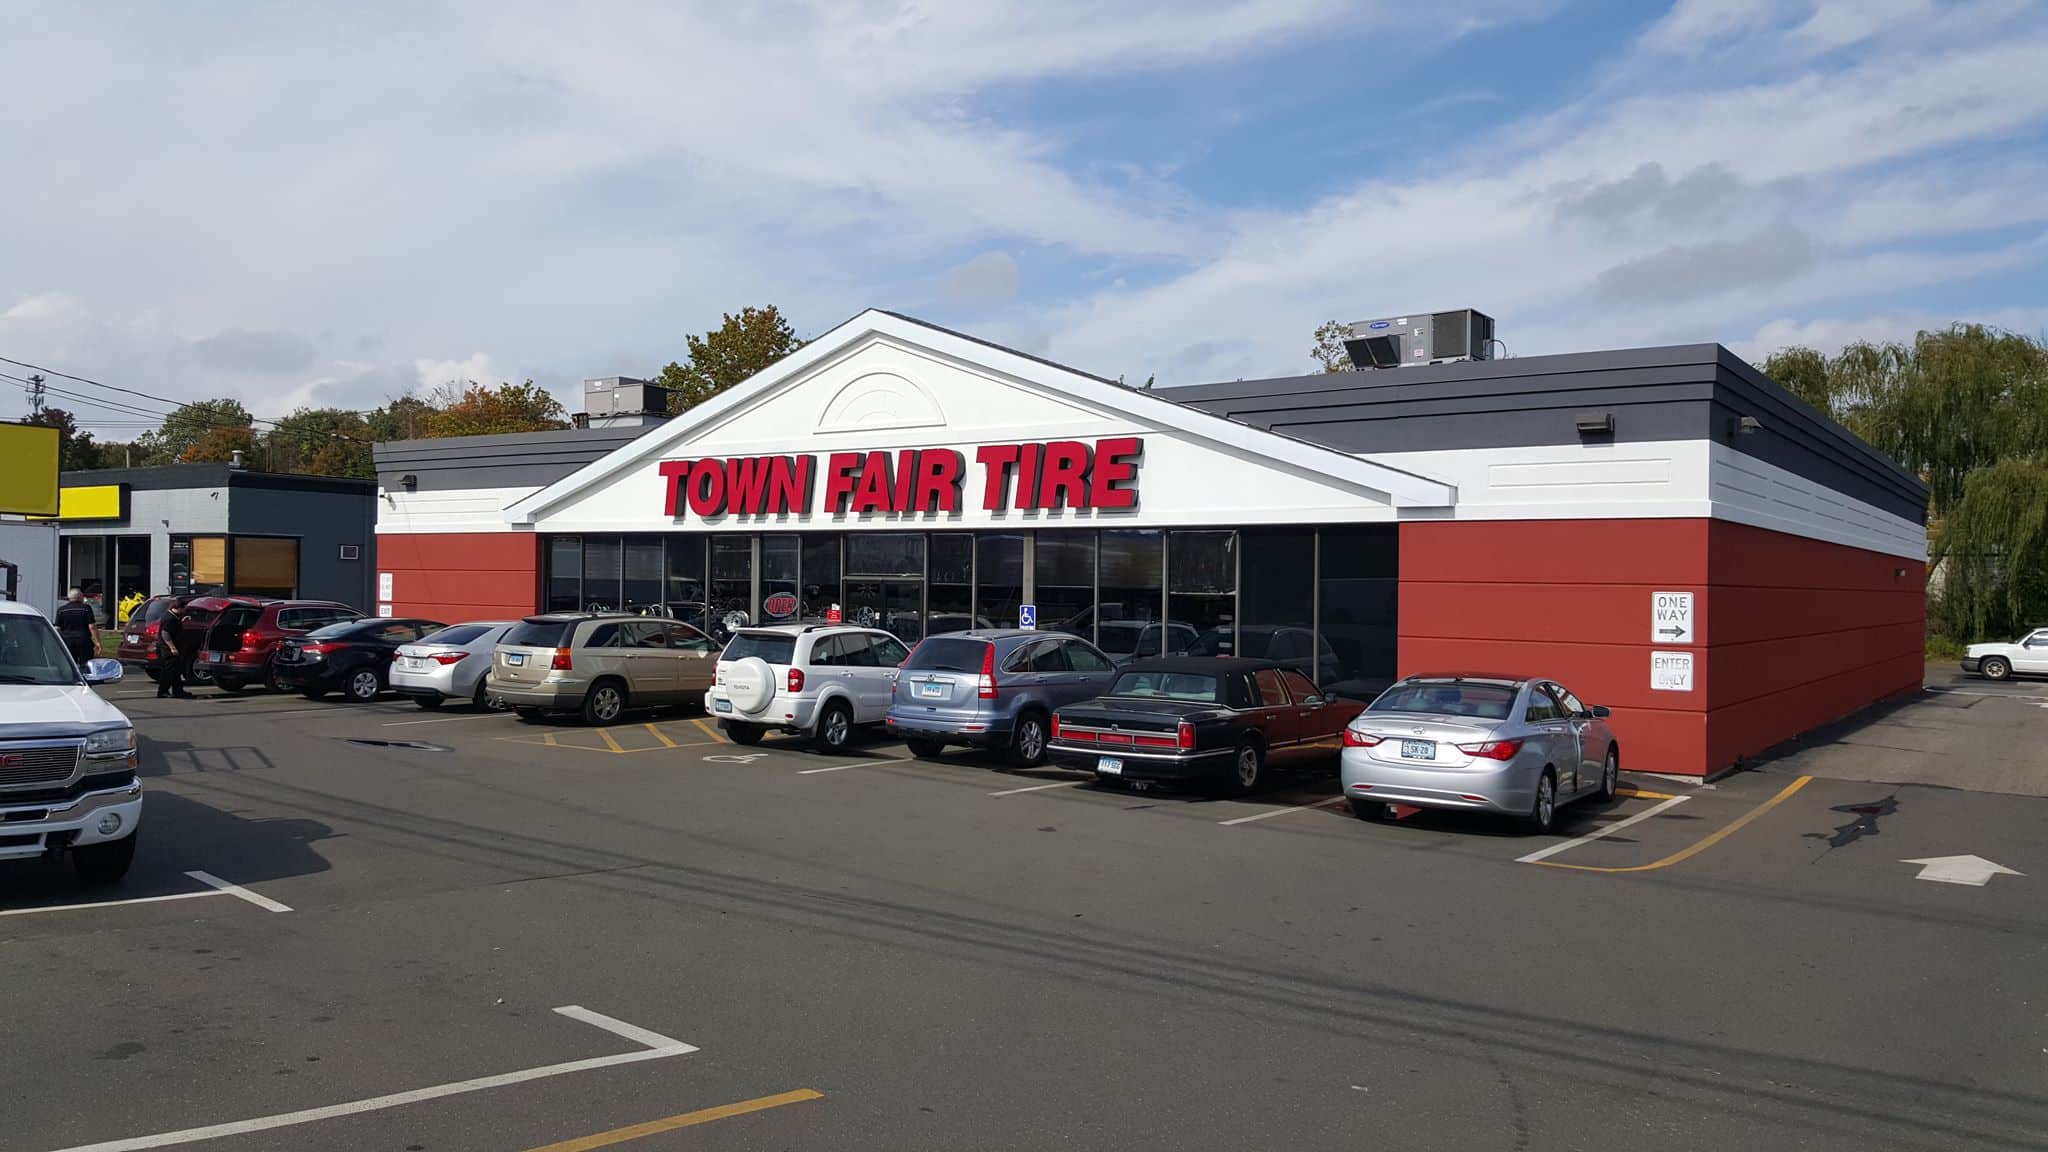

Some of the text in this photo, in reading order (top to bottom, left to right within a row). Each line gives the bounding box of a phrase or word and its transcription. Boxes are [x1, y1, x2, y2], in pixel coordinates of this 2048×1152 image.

[659, 437, 1144, 517] TOWN FAIR TIRE
[1658, 596, 1688, 608] ONE
[1657, 609, 1688, 621] WAY
[1655, 657, 1690, 669] ENTER
